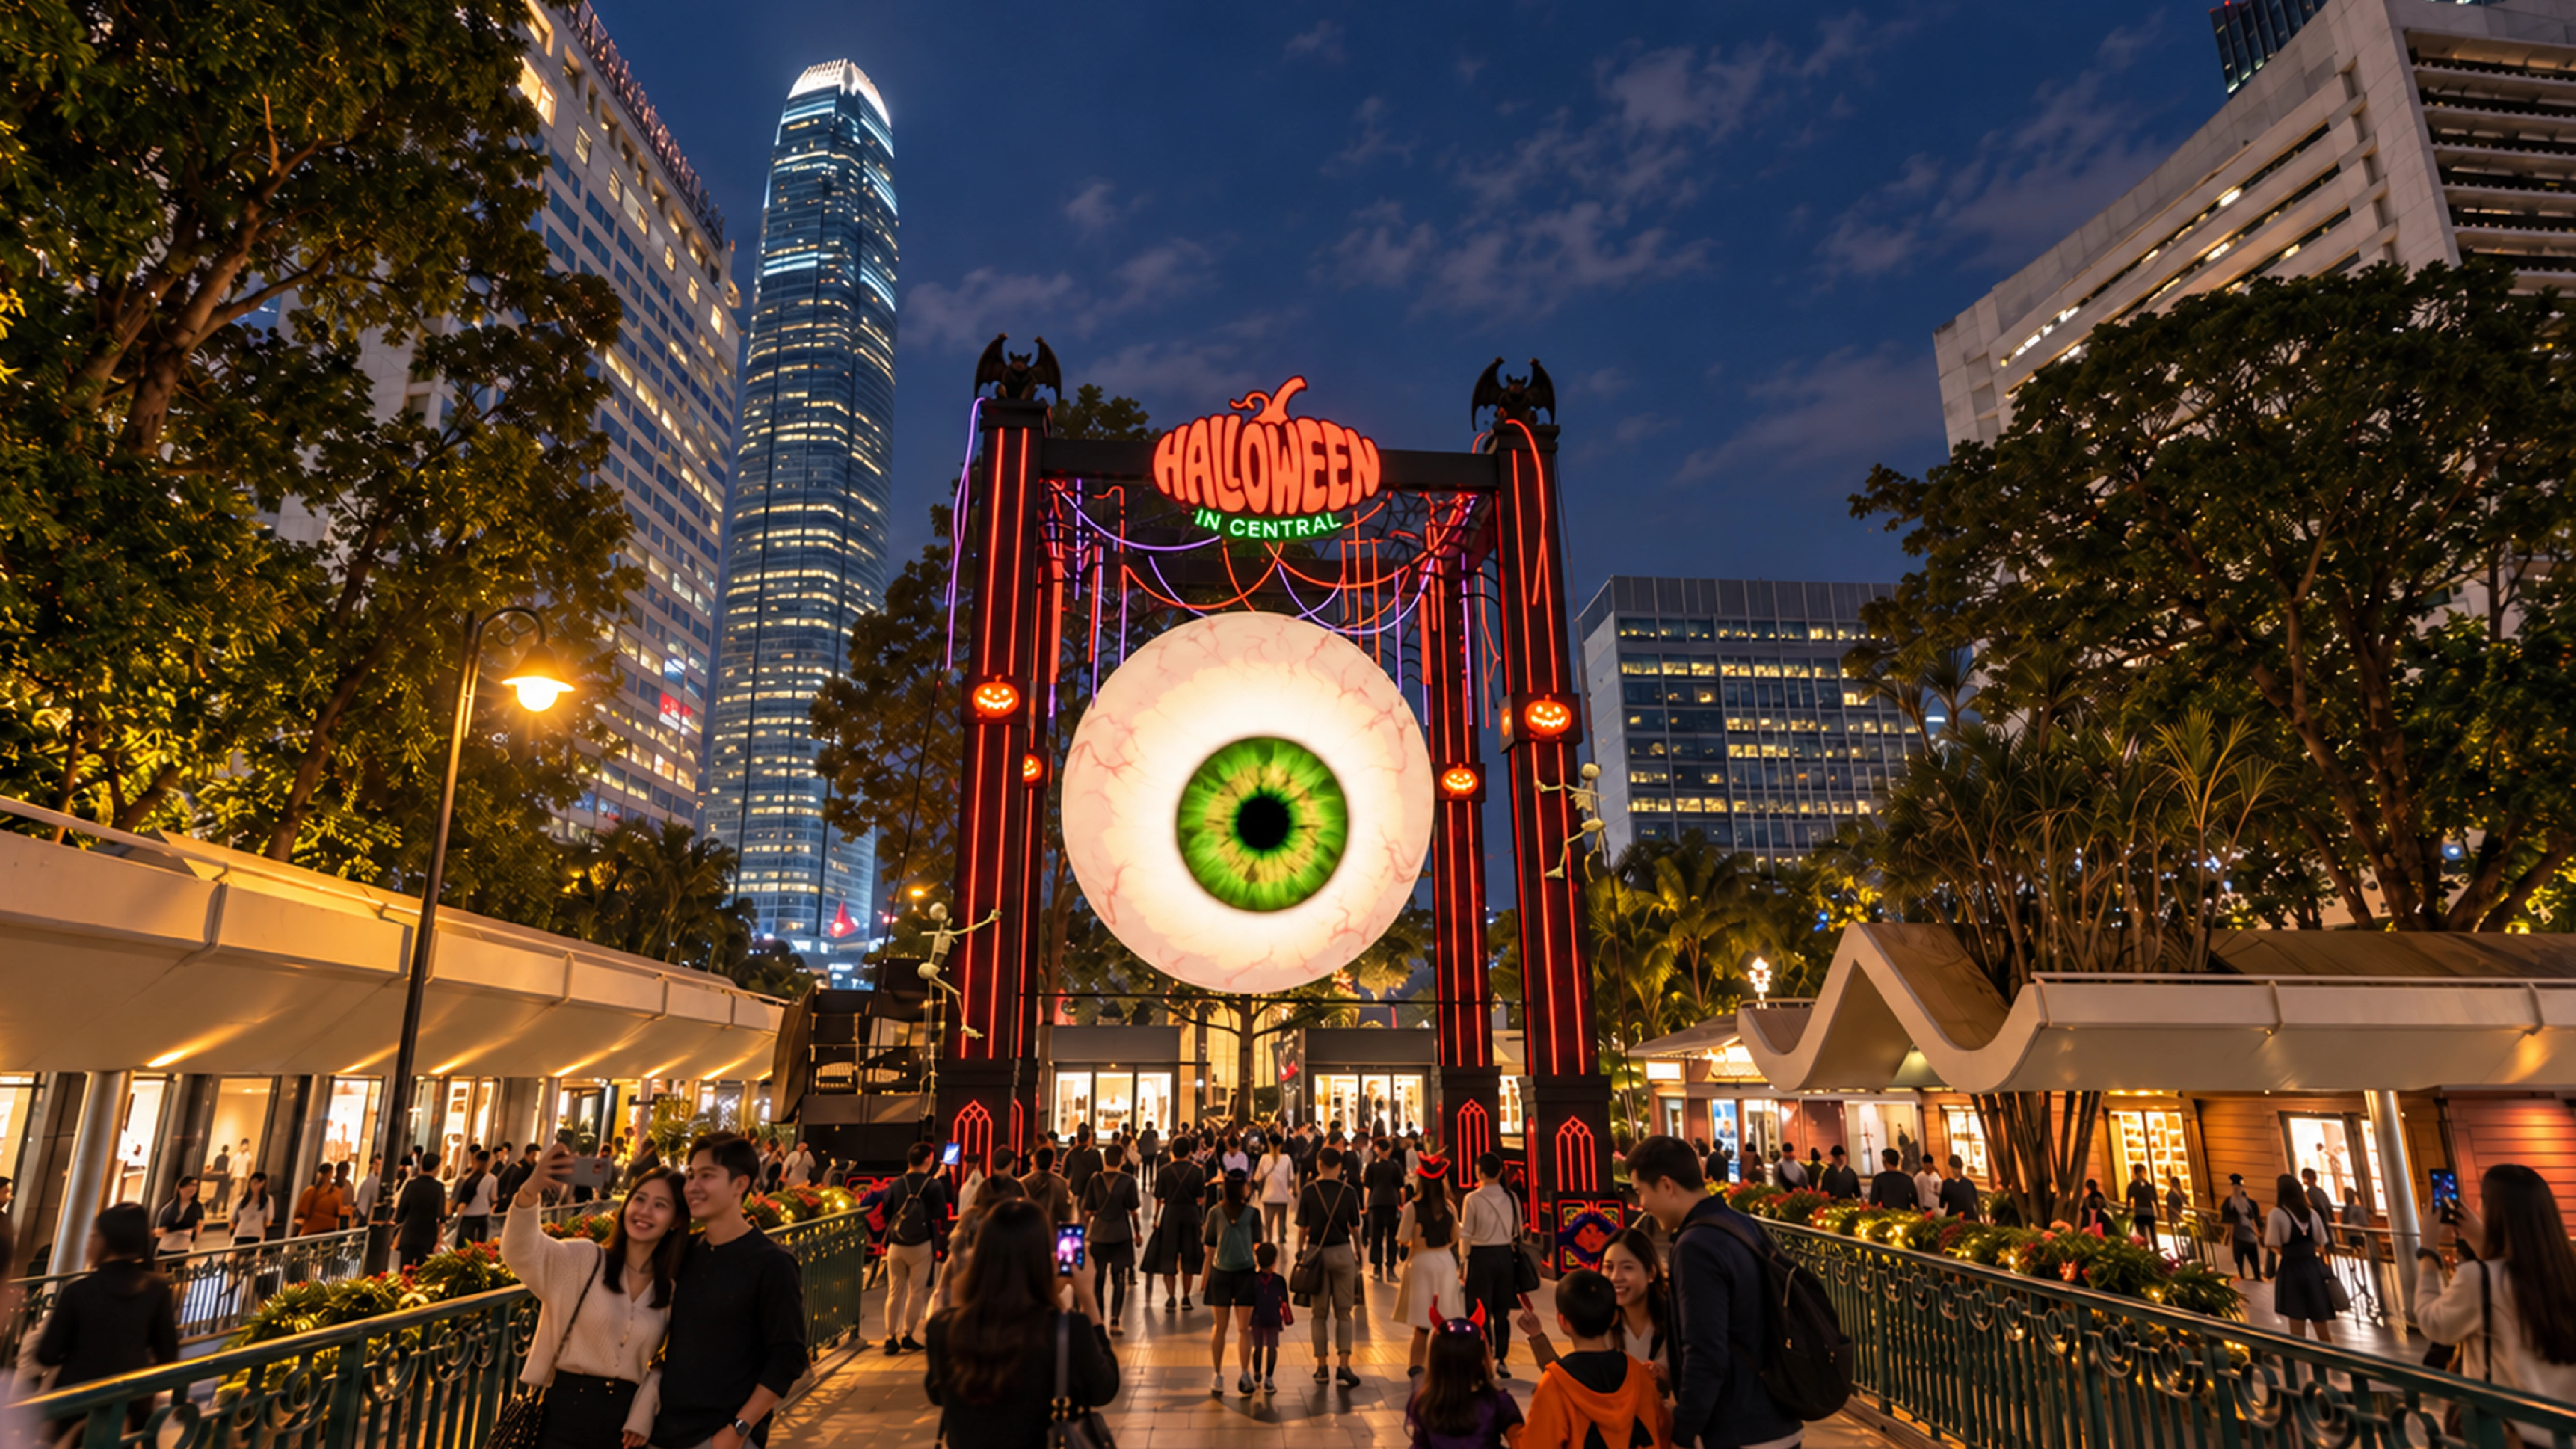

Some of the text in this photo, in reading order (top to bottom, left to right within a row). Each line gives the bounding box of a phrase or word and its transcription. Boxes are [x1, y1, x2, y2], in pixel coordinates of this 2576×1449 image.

[1153, 414, 1380, 515] HALLOWEEN
[1195, 509, 1342, 538] IN CENTRAL
